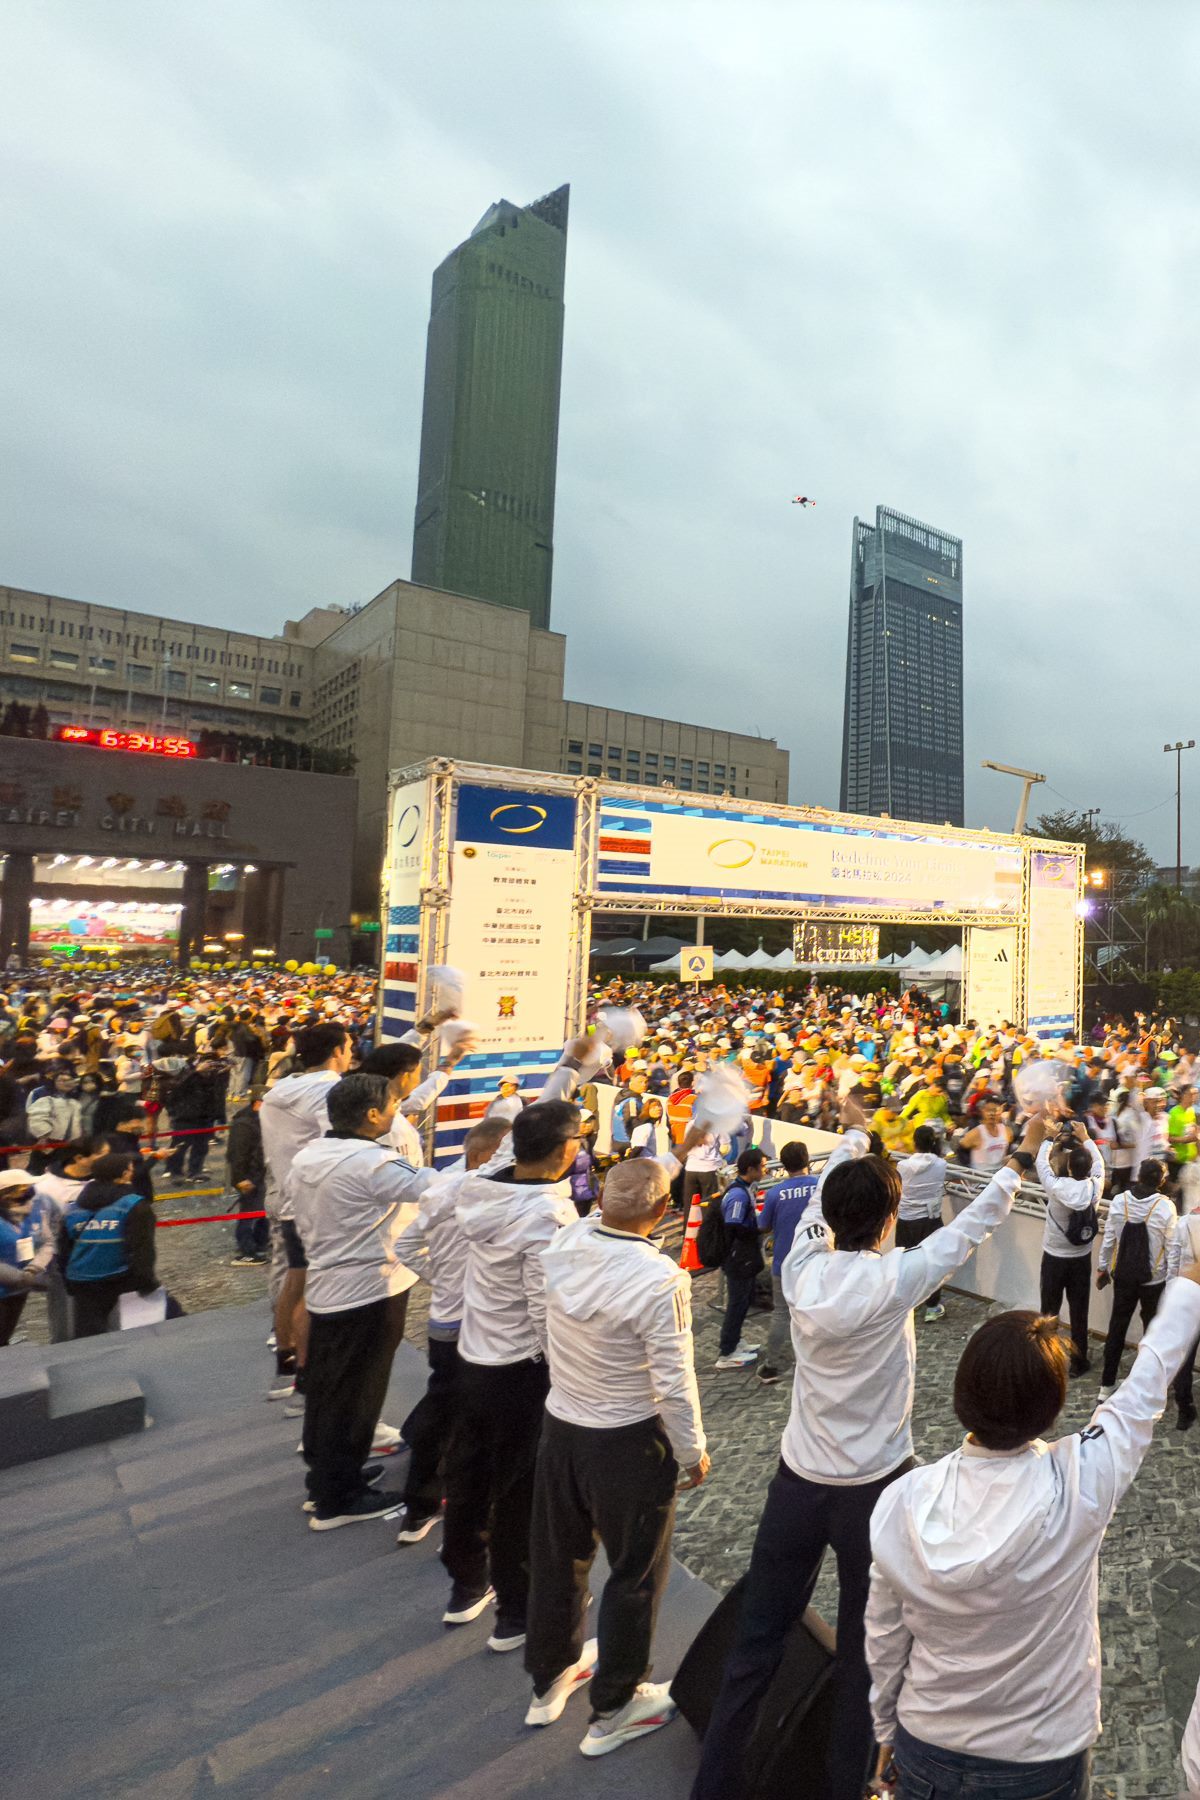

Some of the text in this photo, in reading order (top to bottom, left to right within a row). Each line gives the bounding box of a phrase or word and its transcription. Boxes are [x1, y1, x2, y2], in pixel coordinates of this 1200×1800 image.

[101, 729, 189, 755] 6:34:55
[101, 815, 155, 833] CITY
[175, 820, 233, 839] HALL
[760, 848, 789, 858] TAIPEI
[831, 849, 889, 868] Redefine
[759, 858, 808, 869] MARATHON
[817, 949, 865, 961] CITIZEN
[779, 1185, 816, 1201] STAFF
[75, 1219, 120, 1231] SAFF
